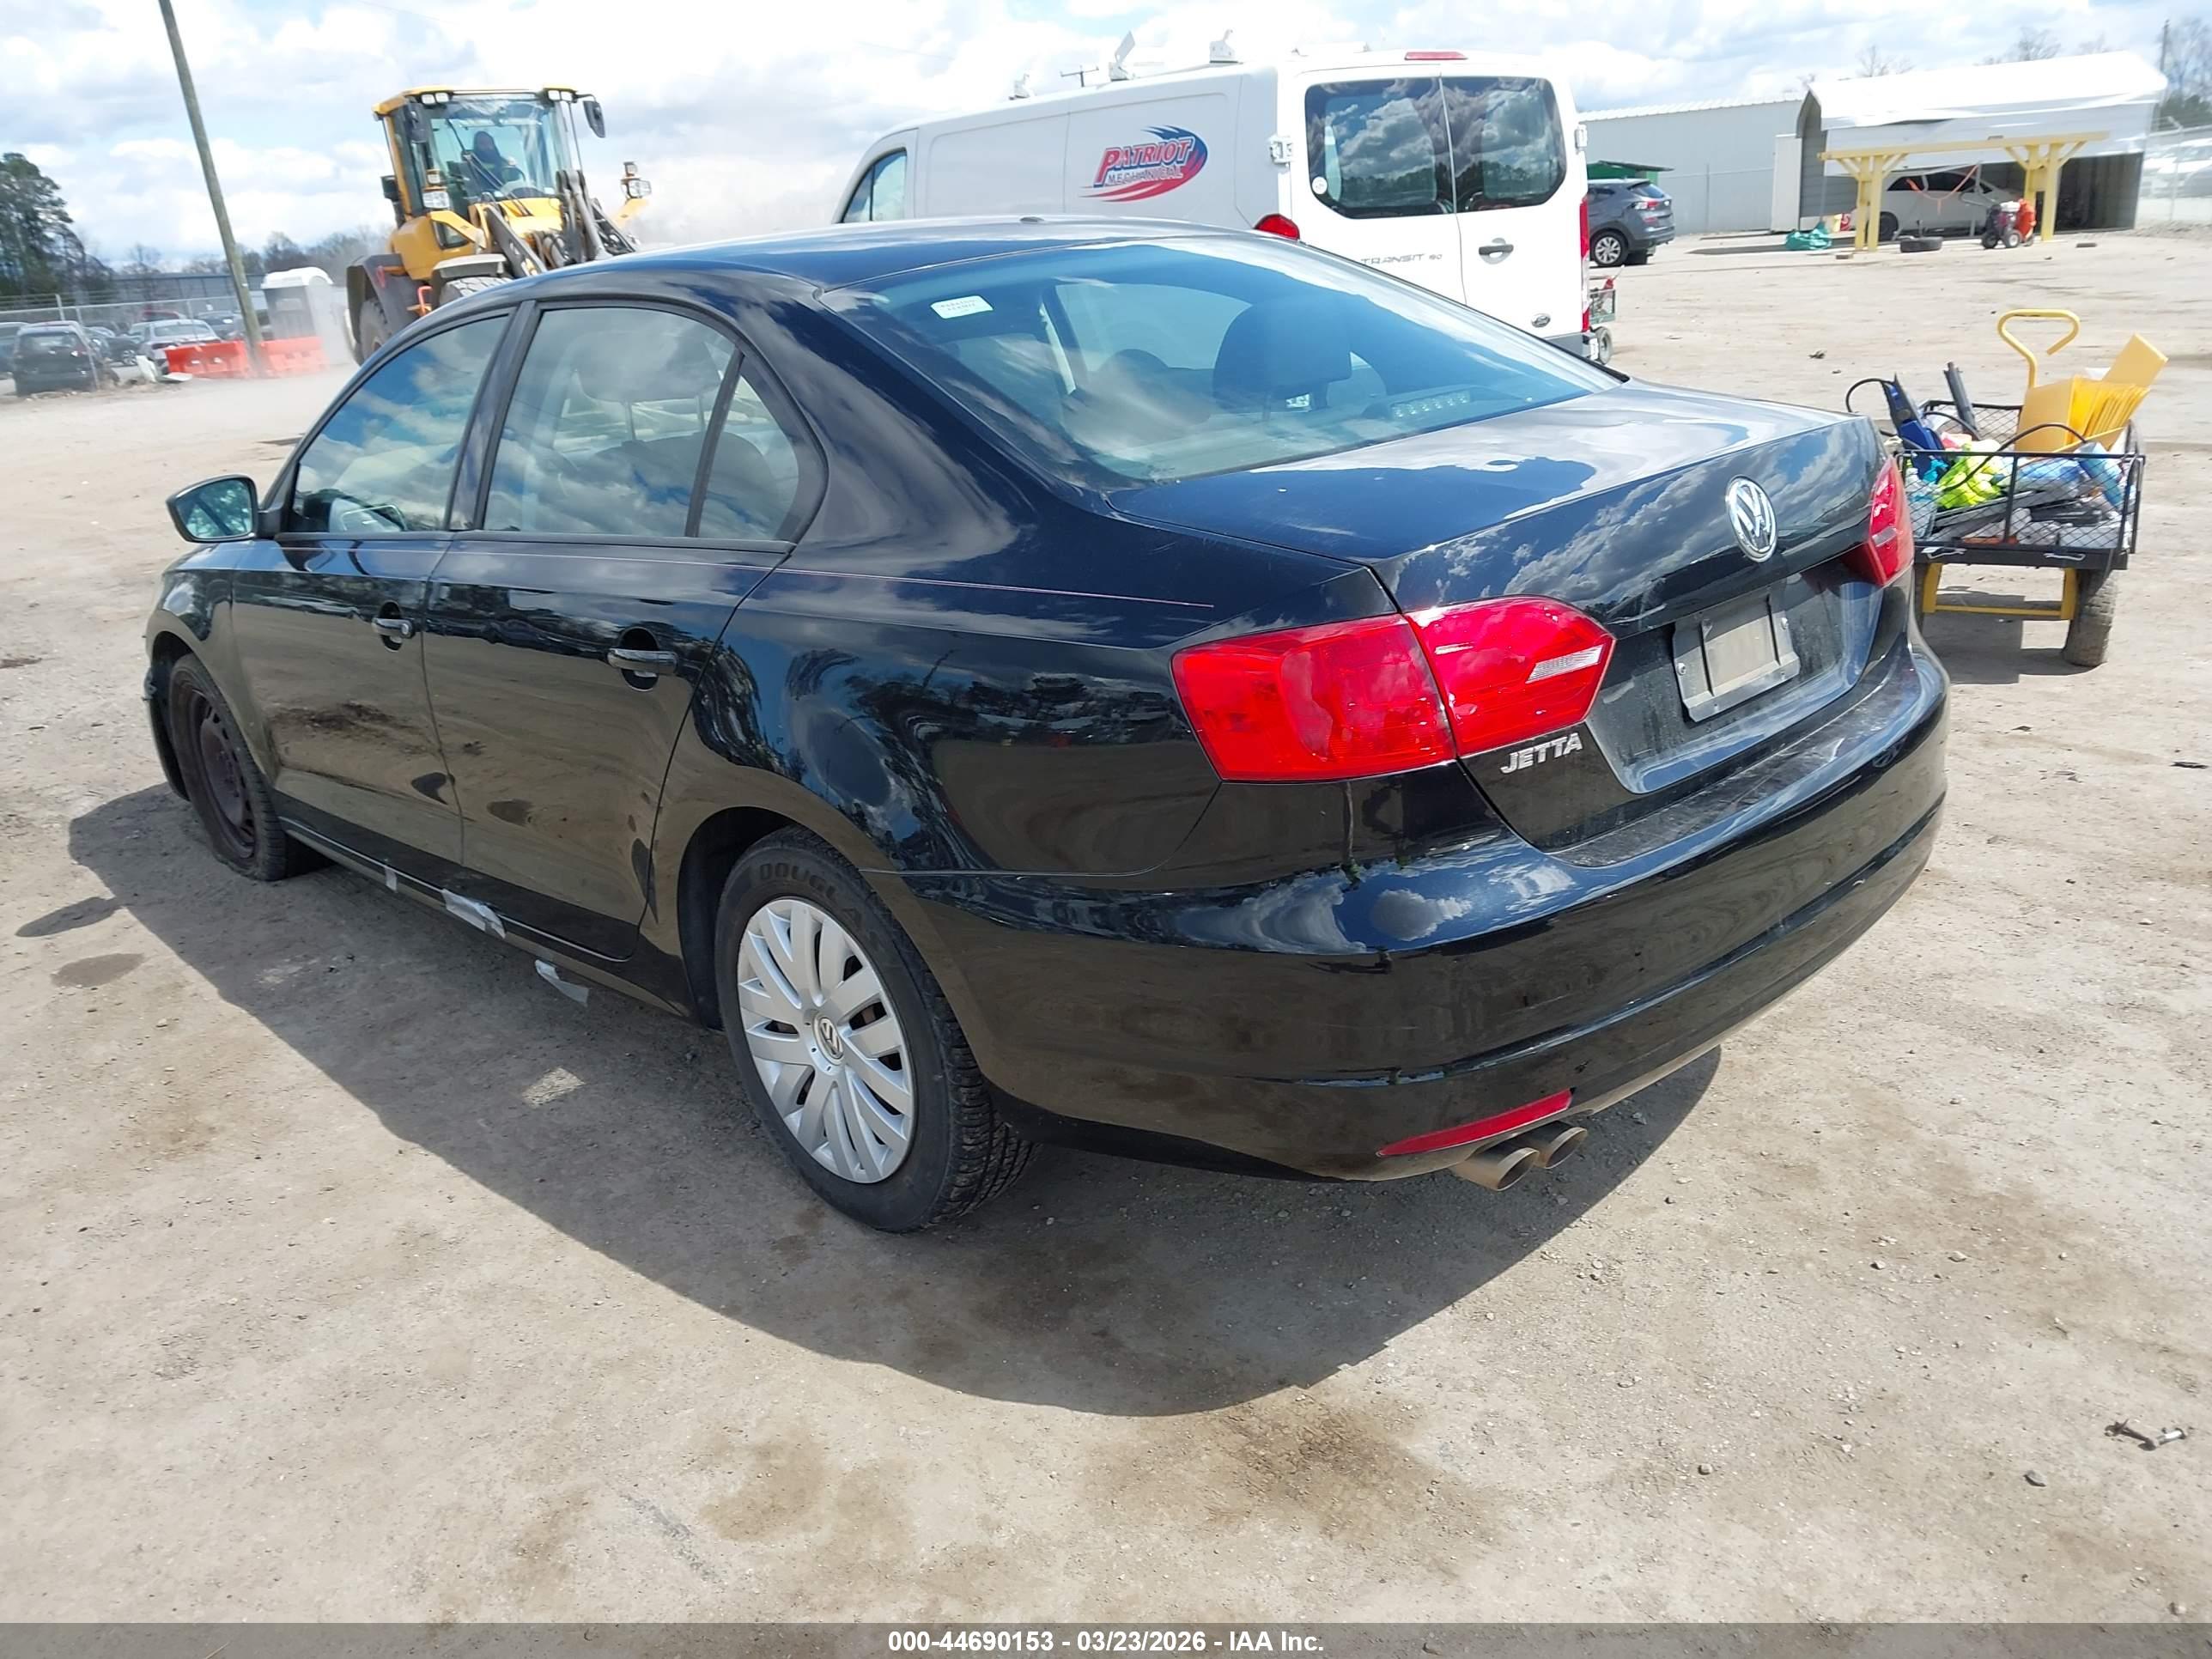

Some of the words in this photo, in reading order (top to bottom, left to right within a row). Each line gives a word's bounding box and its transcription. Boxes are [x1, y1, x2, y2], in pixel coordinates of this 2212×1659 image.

[1094, 137, 1193, 186] PATRIOT
[1108, 166, 1183, 184] MECHANICAL
[1499, 732, 1583, 774] JETTA
